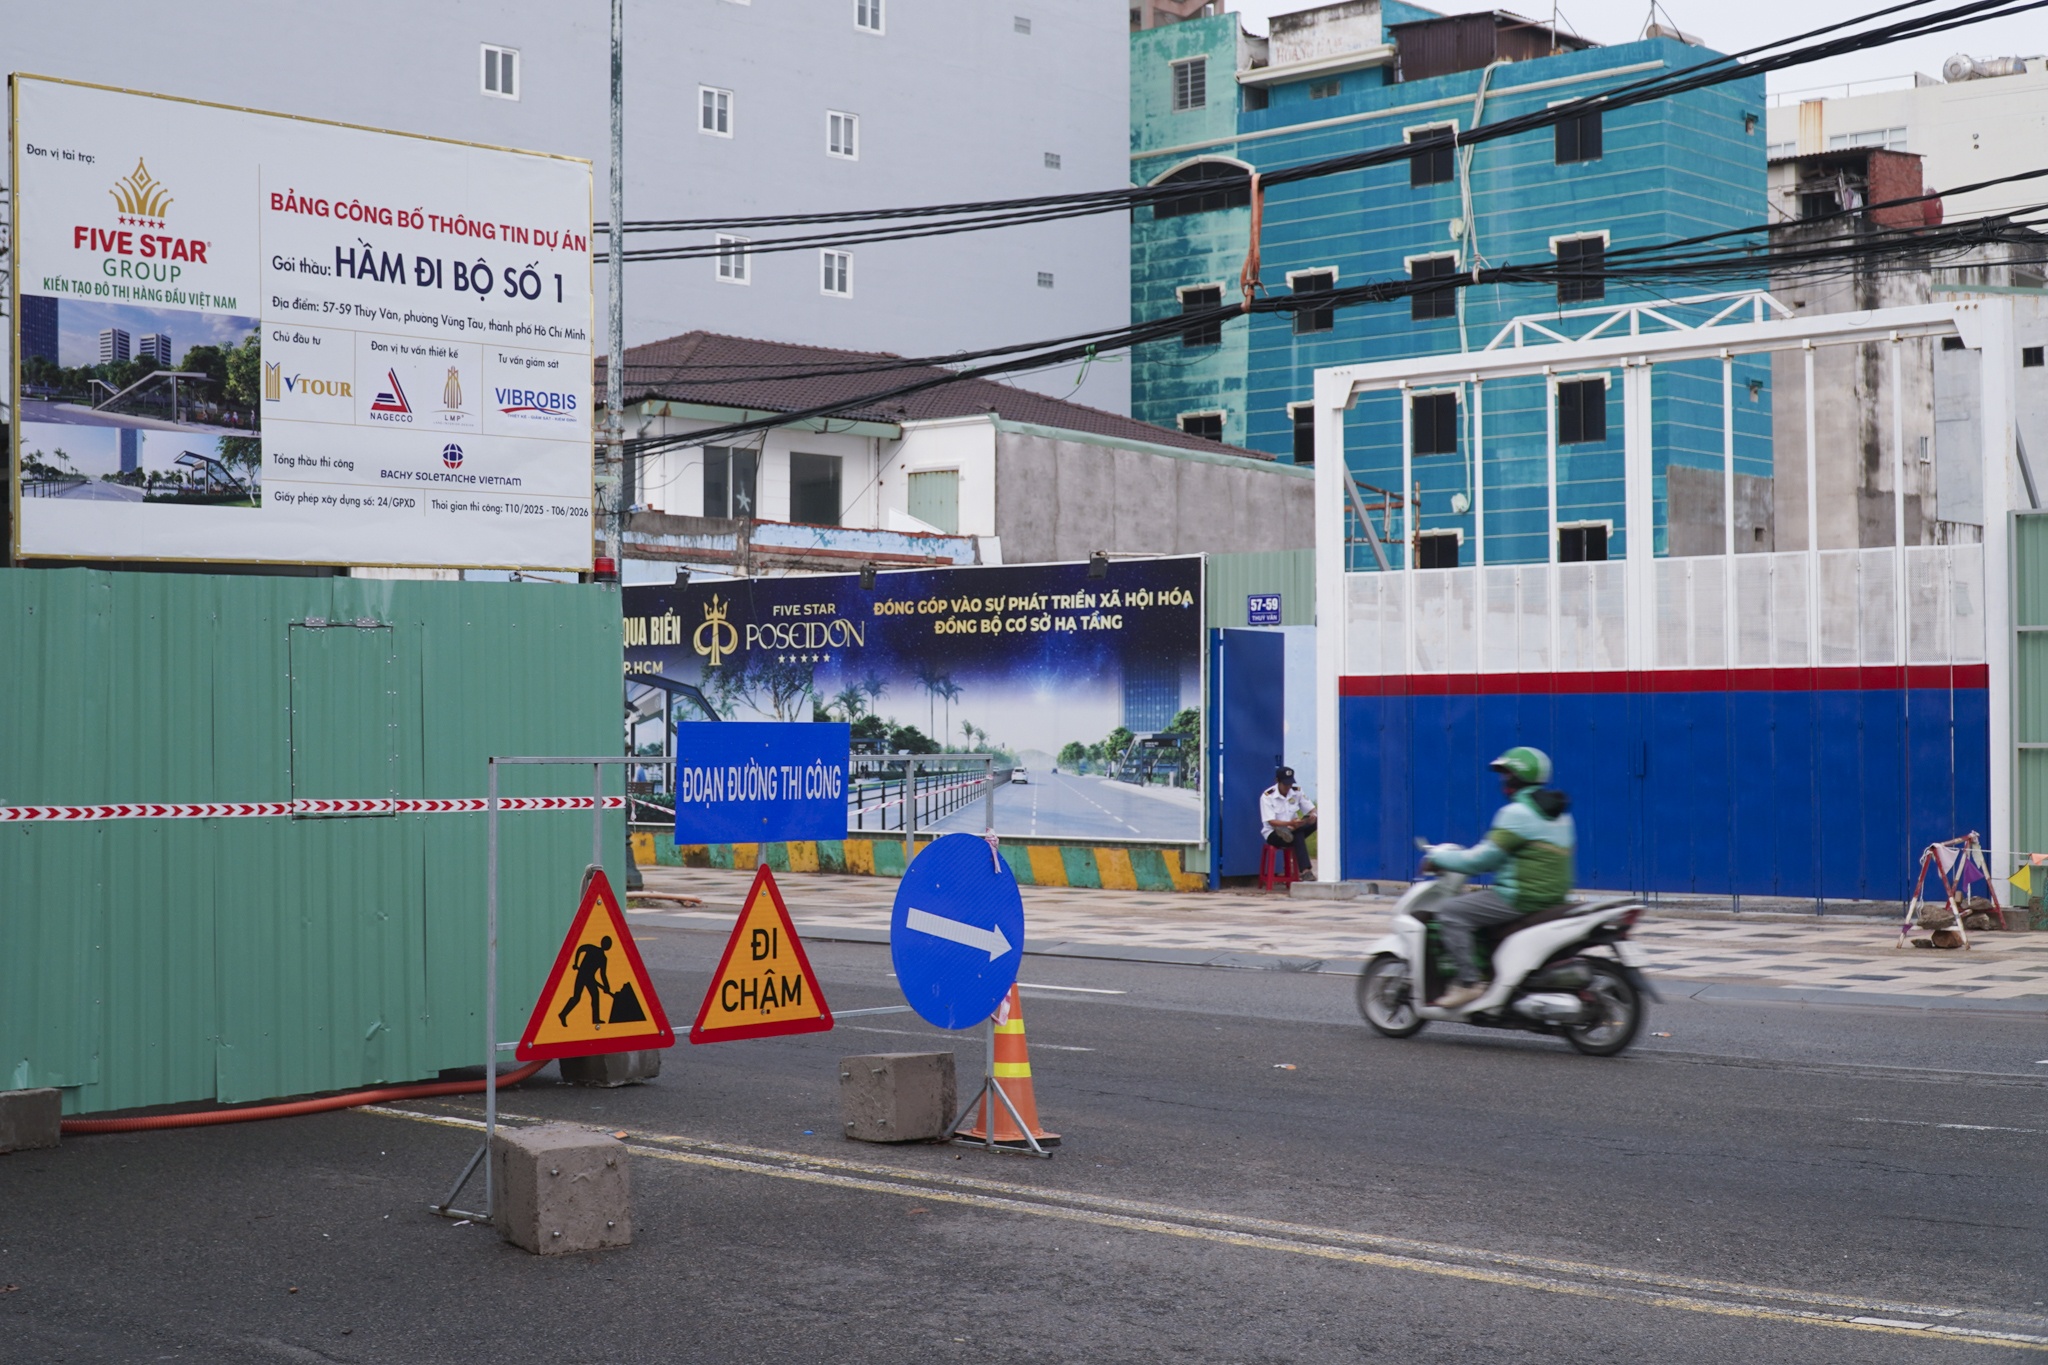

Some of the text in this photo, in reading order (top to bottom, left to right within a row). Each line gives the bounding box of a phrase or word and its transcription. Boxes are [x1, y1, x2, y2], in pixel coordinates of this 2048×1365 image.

[50, 148, 60, 161] vị
[63, 149, 75, 161] tài
[271, 188, 586, 252] BẢNG CÔNG BỐ THÔNG TIN DỰ ÁN
[74, 226, 133, 255] FIVE
[103, 258, 181, 283] GROUP
[272, 237, 562, 303] Gói thầu: HẦM ĐI BỘ SỐ 1
[43, 275, 69, 292] KIẾN
[72, 280, 92, 298] TẠO
[94, 281, 109, 296] ĐÔ
[112, 284, 130, 302] THỊ
[133, 285, 162, 302] HÀNG
[188, 291, 210, 309] VIỆT
[214, 296, 237, 309] NAM
[272, 296, 289, 310] Địa
[292, 297, 319, 312] điểm:
[322, 301, 351, 314] 57-59
[379, 307, 401, 322] Vân,
[441, 314, 464, 330] Vũng
[467, 317, 486, 331] Tàu,
[489, 318, 513, 332] thành
[516, 322, 531, 336] phố
[534, 324, 546, 336] Hồ
[549, 326, 562, 338] Chí
[565, 328, 586, 340] Minh
[272, 330, 290, 342] Chủ
[390, 343, 398, 355] vị
[428, 345, 446, 357] thiết
[448, 347, 459, 358] kế
[525, 356, 545, 368] giám
[547, 359, 559, 369] sát
[495, 387, 577, 410] VIBROBIS
[370, 412, 413, 423] NAGECCO
[273, 453, 354, 471] Tổng thầu thi công
[380, 469, 413, 480] BACHY
[274, 491, 295, 504] Giấy
[298, 492, 319, 505] phép
[321, 494, 337, 507] xây
[363, 496, 375, 506] số:
[378, 496, 415, 508] 24/GPXD
[450, 500, 467, 513] gian
[470, 501, 479, 511] thi
[482, 503, 503, 515] công:
[505, 503, 544, 515] T10/2025
[552, 506, 589, 517] T06/2026
[773, 603, 836, 616] FIVE STAR
[873, 586, 1194, 616] ĐÓNG GÓP VÀO SỰ PHÁT TRIỂN XÃ HỘI HÓA
[1250, 598, 1278, 611] 57-59
[623, 606, 681, 648] QUA BIỂN
[745, 618, 865, 650] POSEIDON
[934, 610, 1123, 636] ĐỒNG BỘ CƠ SỞ HẠ TẦNG
[682, 757, 841, 809] ĐOẠN ĐƯỜNG THI CÔNG
[751, 927, 778, 961] ĐI
[721, 968, 802, 1014] CHẬM
